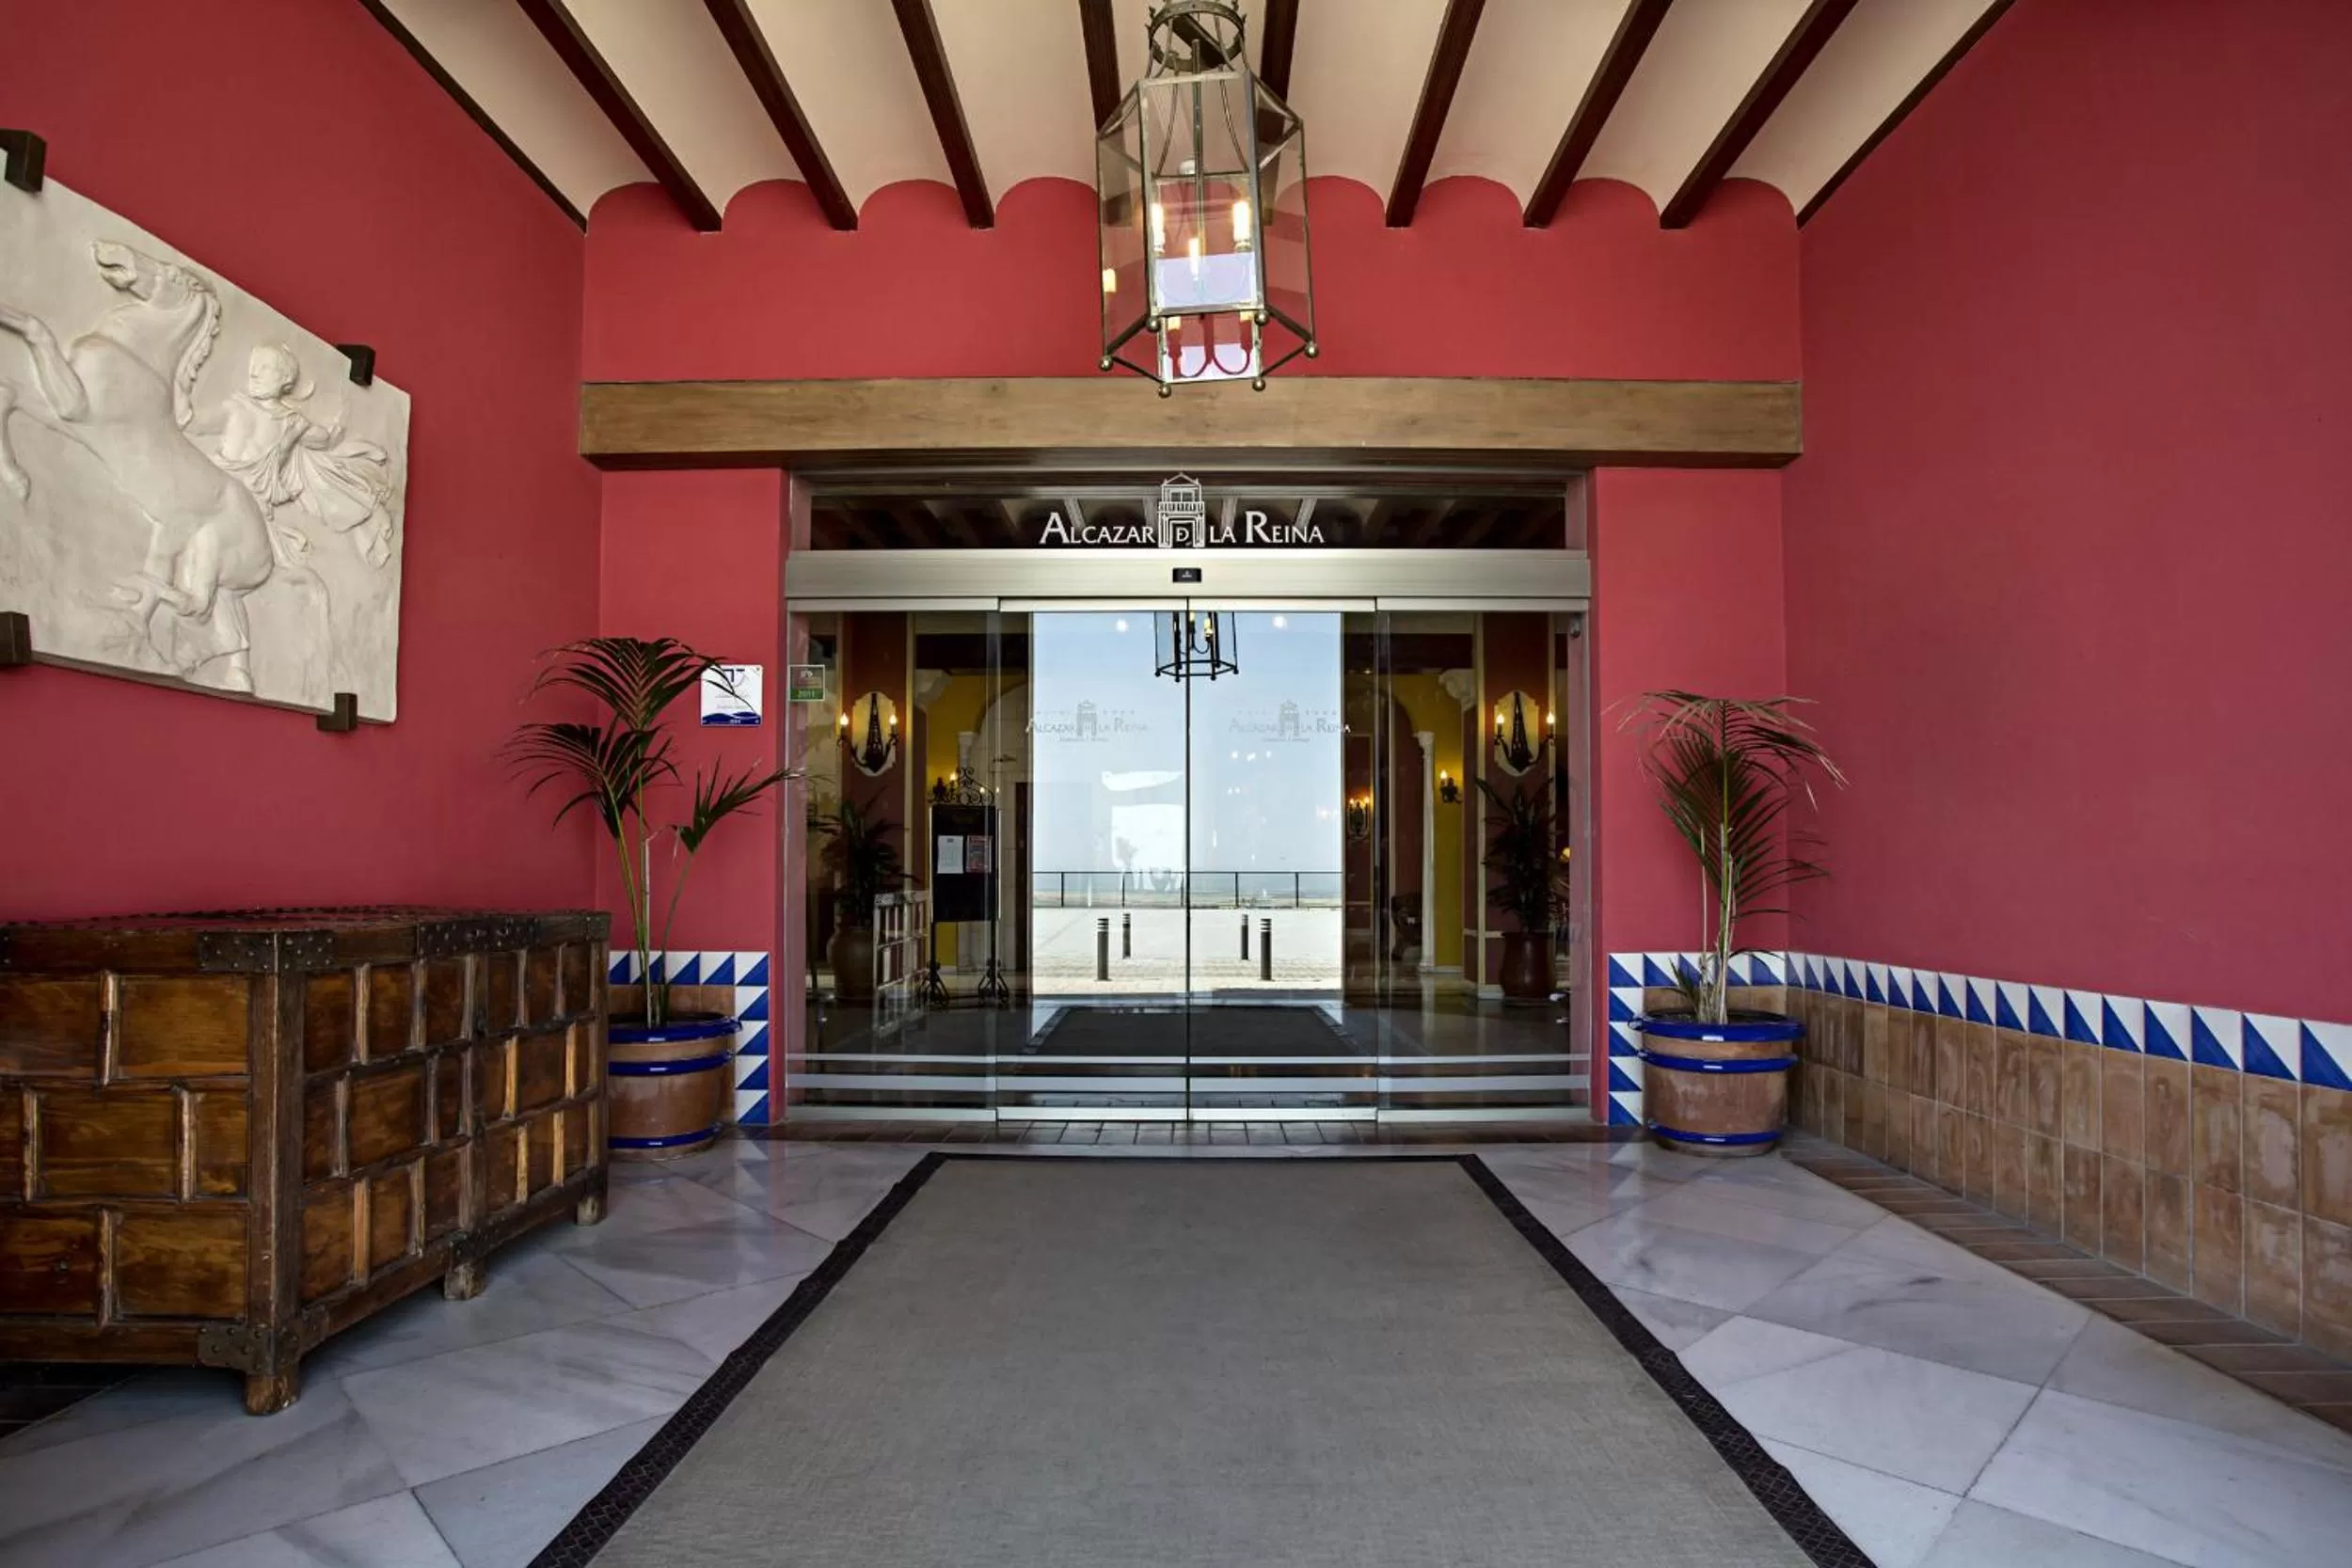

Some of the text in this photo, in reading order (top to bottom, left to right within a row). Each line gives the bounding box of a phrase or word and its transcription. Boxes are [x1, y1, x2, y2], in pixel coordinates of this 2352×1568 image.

[1039, 511, 1156, 544] ALCAZAR
[1209, 526, 1237, 544] LA
[1245, 511, 1326, 544] REINA
